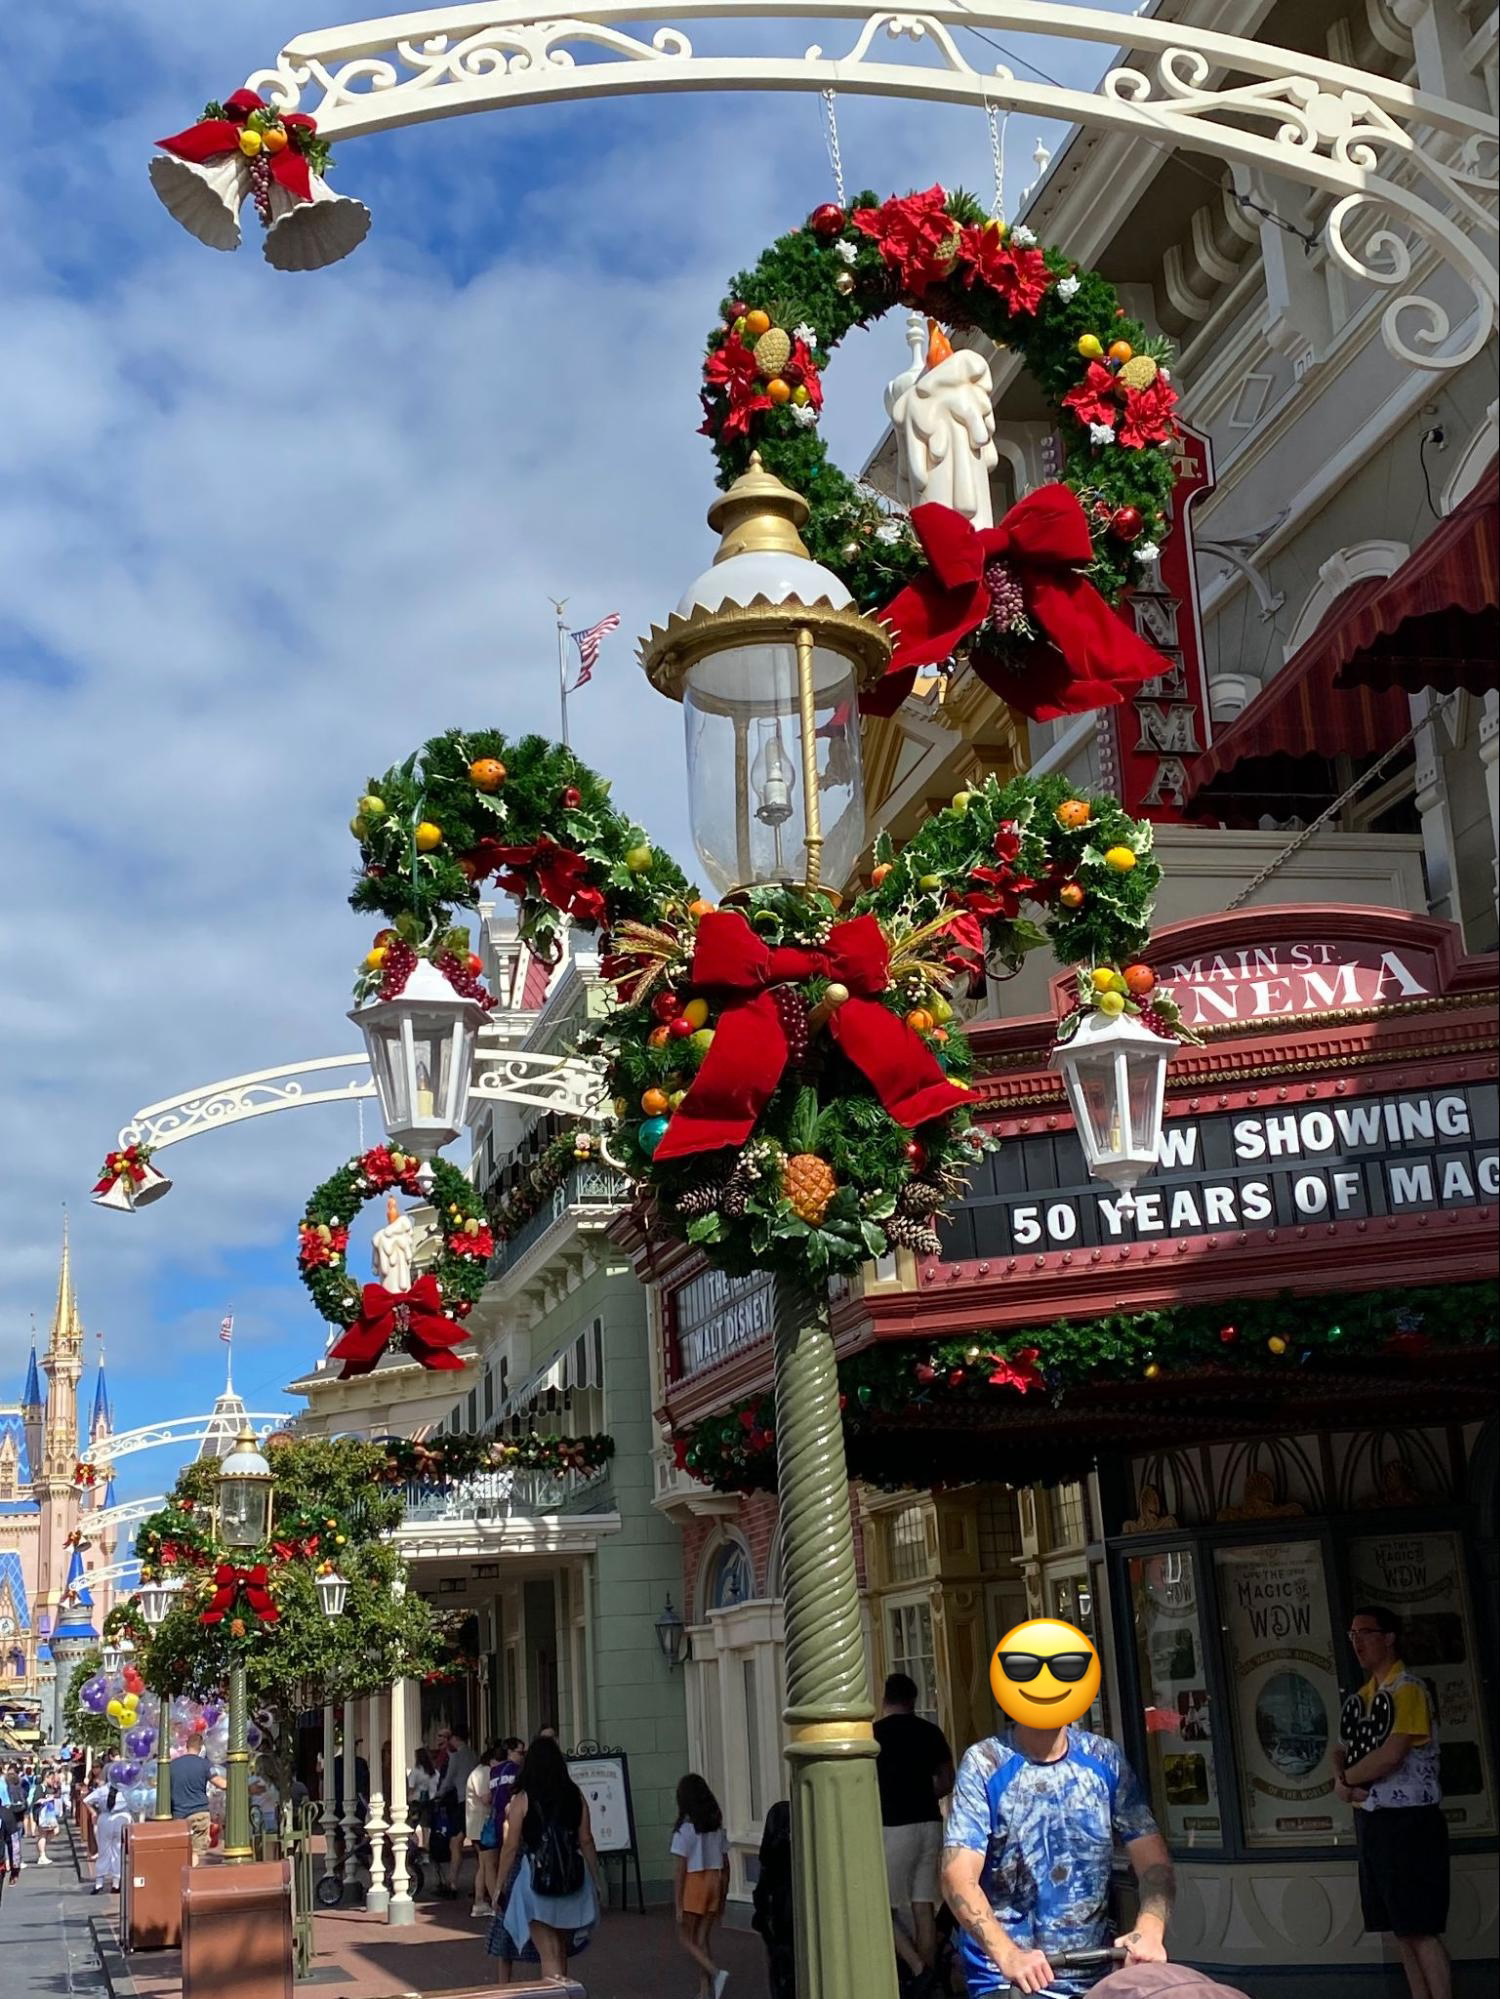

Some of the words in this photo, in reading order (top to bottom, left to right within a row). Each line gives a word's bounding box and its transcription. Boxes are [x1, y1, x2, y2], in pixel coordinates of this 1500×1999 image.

[1172, 455, 1203, 479] T.
[1127, 493, 1203, 806] INEMA
[1170, 947, 1278, 983] MAIN
[1290, 944, 1342, 971] ST.
[1163, 951, 1429, 1023] NEMA
[1233, 1096, 1470, 1159] SHOWING
[1013, 1203, 1077, 1244] 50
[1098, 1182, 1272, 1235] YEARS
[1294, 1172, 1360, 1214] OF
[695, 1320, 723, 1362] WALT
[726, 1290, 768, 1346] DISNEY
[1264, 1568, 1284, 1581] THE
[1375, 1549, 1414, 1566] MAGIC
[1382, 1563, 1426, 1588] WDW
[1238, 1581, 1292, 1606] MAGIC
[1248, 1604, 1311, 1640] WDW
[1282, 1790, 1298, 1800] THE
